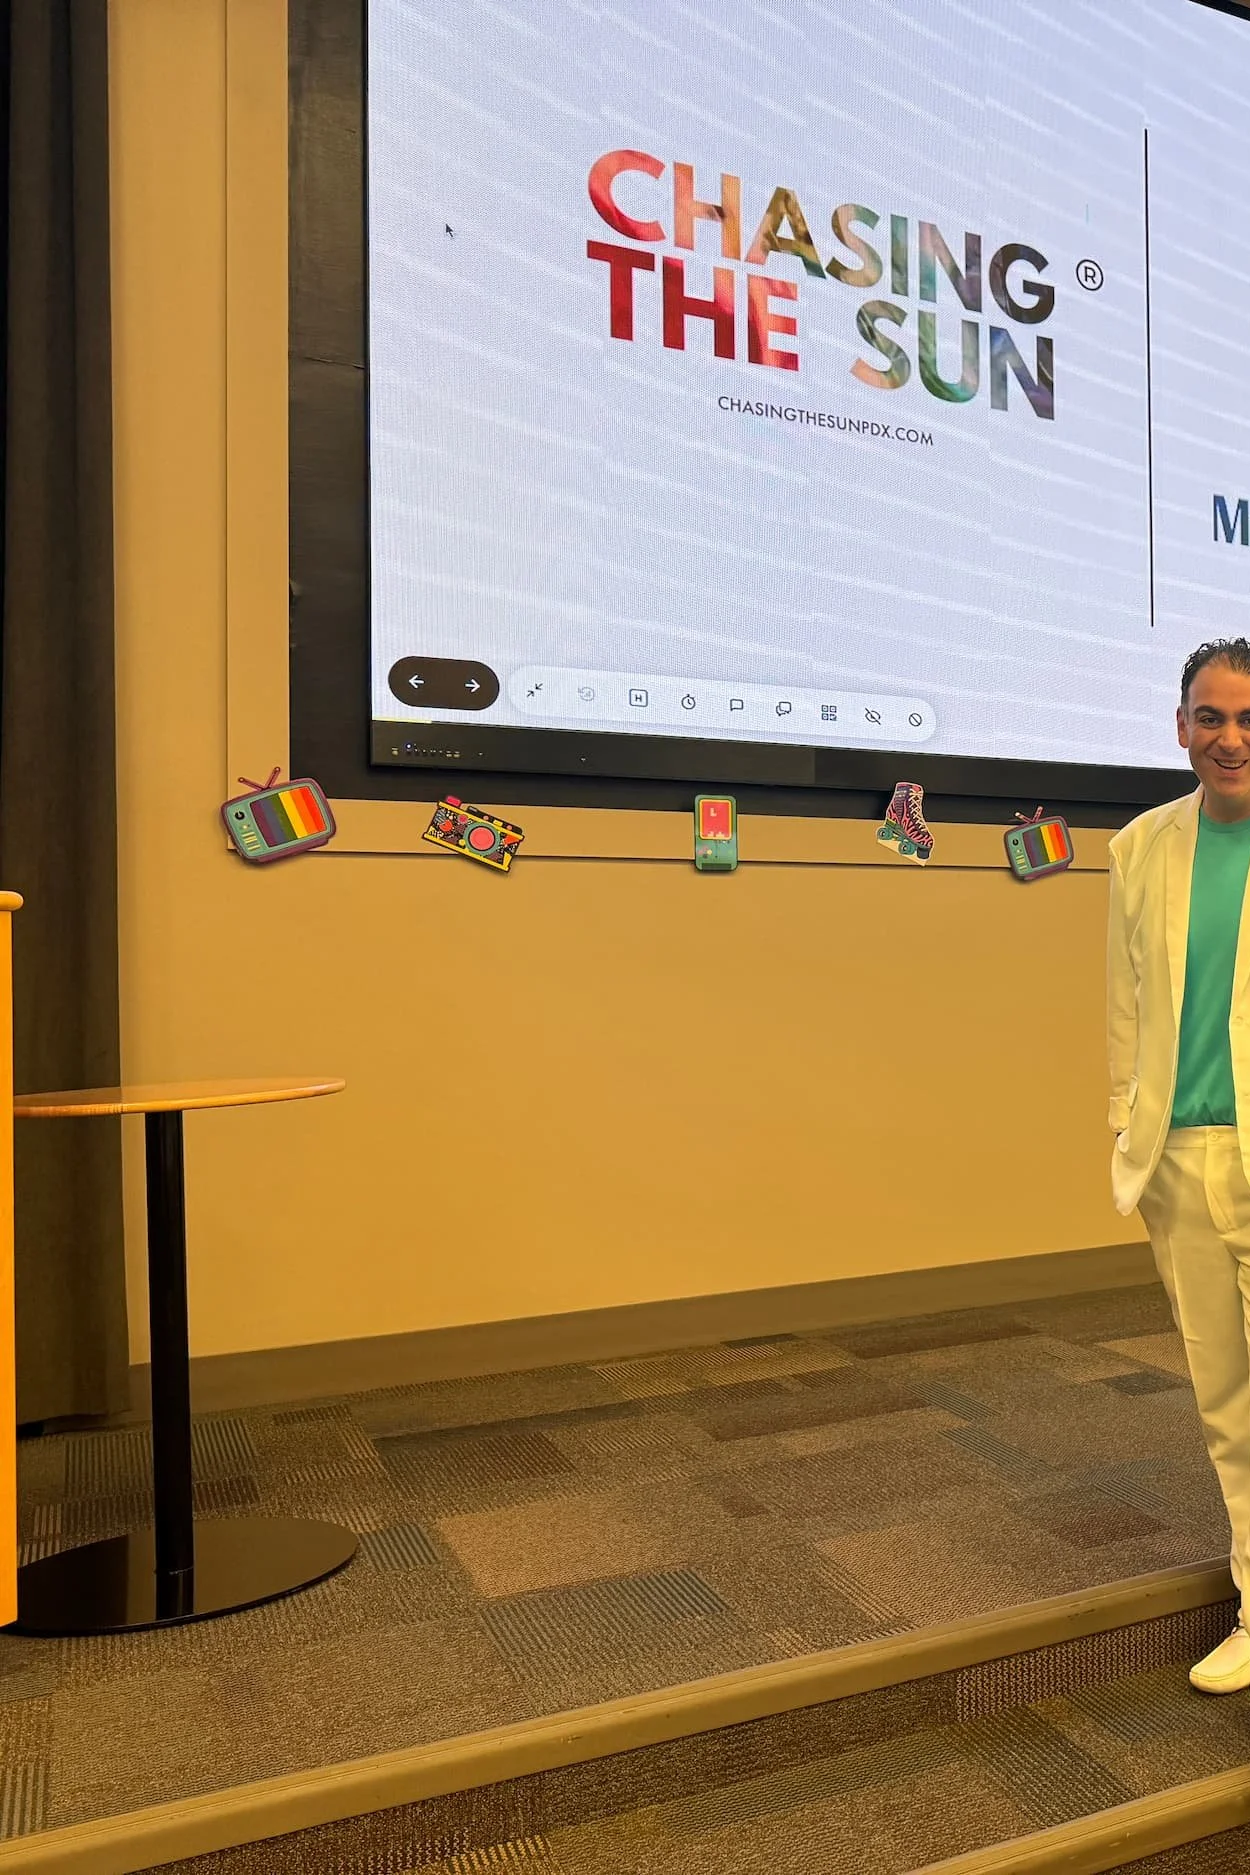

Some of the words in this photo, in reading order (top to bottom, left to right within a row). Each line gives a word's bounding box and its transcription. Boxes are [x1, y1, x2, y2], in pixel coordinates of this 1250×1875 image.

[587, 149, 1056, 325] CHASING
[586, 239, 799, 372] THE
[850, 299, 1056, 421] SUN
[717, 395, 935, 447] CHASINGTHESUNPDX.COM
